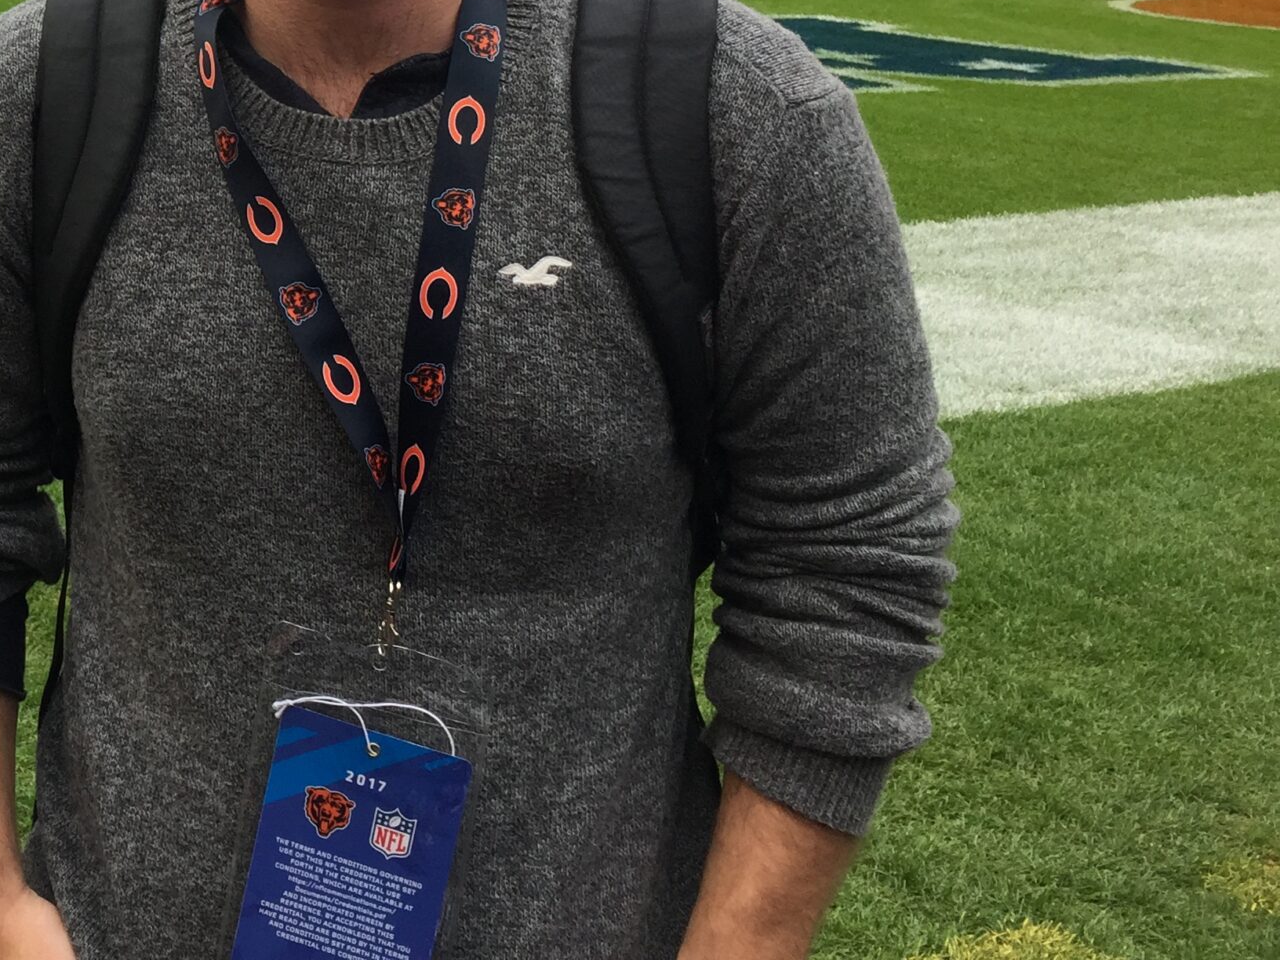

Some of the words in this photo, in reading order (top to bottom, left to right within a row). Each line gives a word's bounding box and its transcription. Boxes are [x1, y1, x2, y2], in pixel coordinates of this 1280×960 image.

[345, 770, 387, 792] 2017
[374, 826, 406, 852] NFL
[274, 836, 289, 845] THE
[289, 840, 315, 854] TERMS
[316, 849, 332, 859] AND
[332, 854, 378, 874] CONDITIONS
[378, 869, 423, 889] GOVERNING
[278, 845, 293, 855] USE
[294, 851, 305, 859] OF
[304, 854, 323, 865] THIS
[323, 860, 338, 870] NFL
[339, 865, 385, 885] CREDENTIAL
[385, 880, 400, 890] ARE
[401, 885, 416, 895] SET
[289, 858, 314, 871] FORTH
[314, 866, 323, 874] IN
[324, 869, 338, 879] THE
[339, 874, 385, 894] CREDENTIAL
[385, 889, 401, 899] USE
[282, 890, 298, 900] AND
[299, 895, 355, 918] INCORPORATED
[355, 913, 384, 927] HEREIN
[384, 923, 395, 931] BY
[322, 877, 347, 890] WHICH
[347, 885, 363, 895] ARE
[363, 890, 403, 908] AVAILABLE
[258, 907, 277, 918] HAVE
[277, 913, 298, 925] READ
[298, 920, 314, 930] AND
[315, 926, 330, 935] ARE
[331, 931, 357, 944] BOUND
[367, 943, 383, 952] THE
[383, 948, 409, 960] TERMS
[268, 919, 284, 929] AND
[284, 924, 330, 944] CONDITIONS
[330, 939, 345, 949] SET
[345, 944, 370, 957] FORTH
[370, 952, 380, 960] IN
[275, 930, 320, 950] CREDENTIAL
[320, 945, 336, 955] USE
[307, 914, 322, 924] YOU
[322, 919, 376, 942] ACKNOWLEDGE
[376, 937, 395, 948] THAT
[395, 943, 411, 953] YOU
[324, 912, 334, 920] BY
[334, 915, 376, 933] ACCEPTING
[376, 928, 394, 939] THIS
